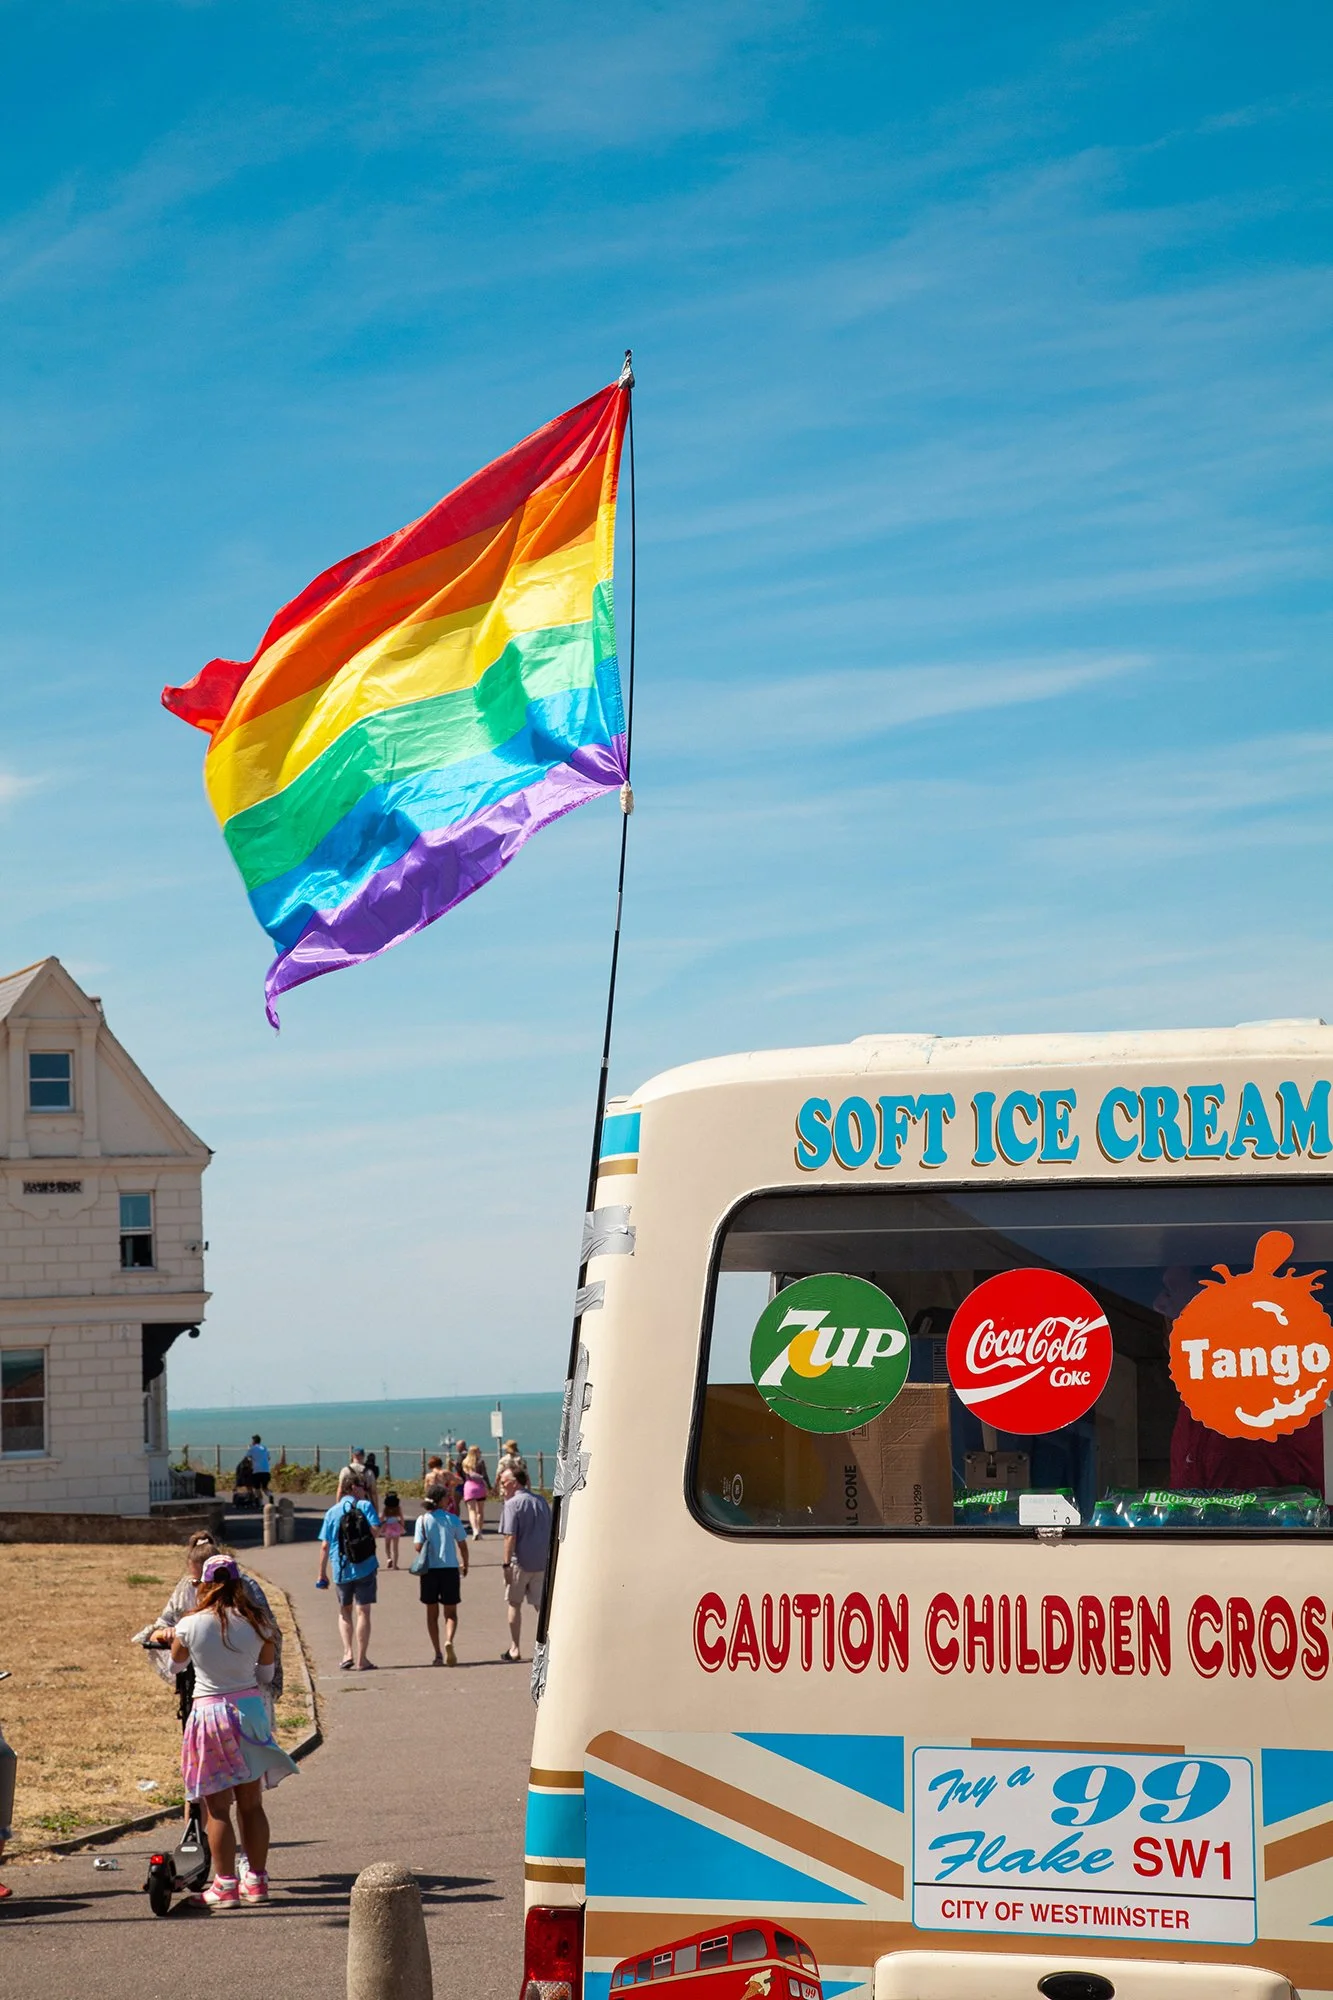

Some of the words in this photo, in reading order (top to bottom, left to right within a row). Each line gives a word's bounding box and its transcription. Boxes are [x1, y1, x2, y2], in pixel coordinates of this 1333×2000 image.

[794, 1092, 956, 1171] SOFT
[971, 1088, 1079, 1166] ICE
[1096, 1080, 1333, 1163] CREAM
[966, 1316, 1088, 1374] Coca-Cola
[1181, 1339, 1331, 1386] Tango
[1050, 1366, 1091, 1387] Coke
[844, 1465, 858, 1510] CONE
[692, 1591, 909, 1674] CAUTION
[924, 1592, 1172, 1677] CHILDREN
[1187, 1594, 1333, 1681] CROS
[928, 1769, 997, 1812] Try
[1007, 1765, 1035, 1788] a
[1050, 1760, 1231, 1827] 99
[928, 1831, 1114, 1881] Flake
[1133, 1837, 1231, 1880] SW1
[941, 1900, 989, 1919] CITY
[995, 1902, 1024, 1921] OF
[1030, 1904, 1190, 1929] WESTMINSTER
